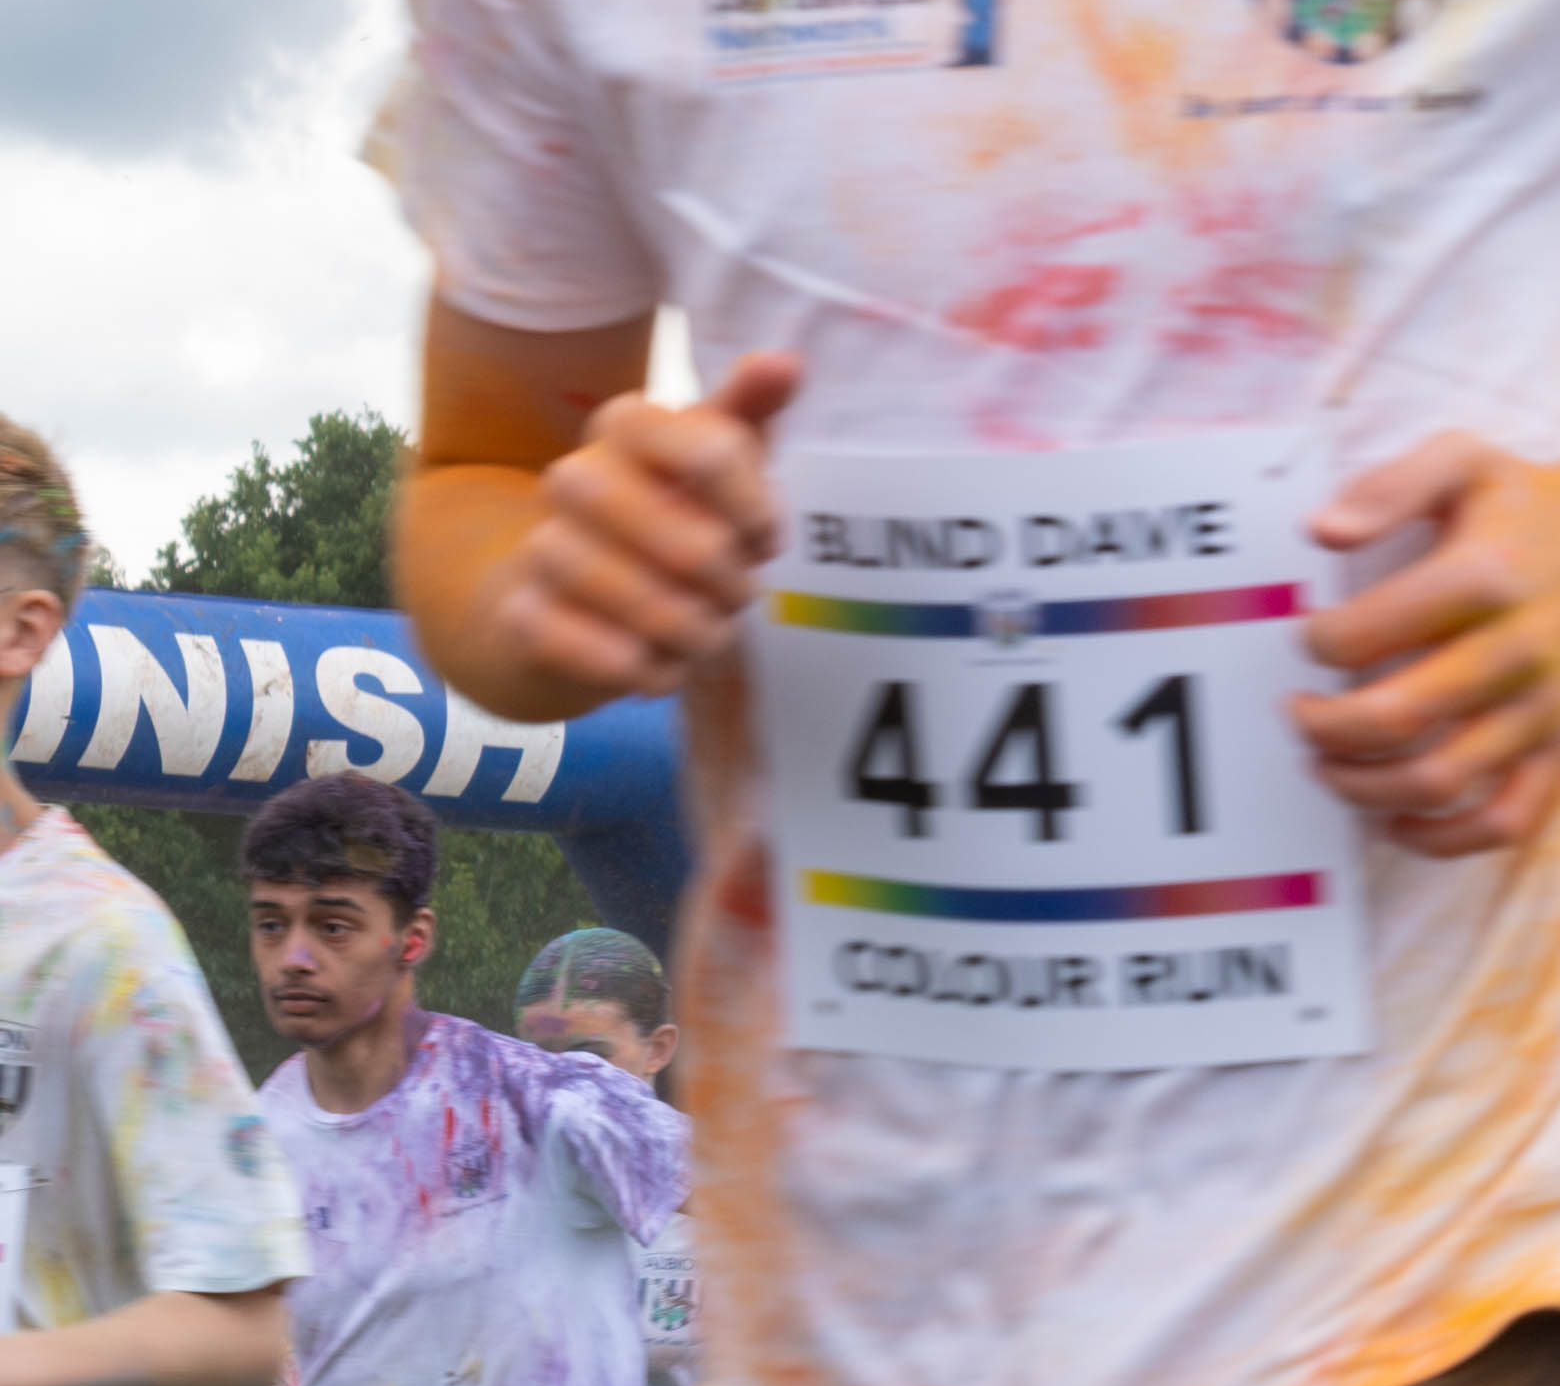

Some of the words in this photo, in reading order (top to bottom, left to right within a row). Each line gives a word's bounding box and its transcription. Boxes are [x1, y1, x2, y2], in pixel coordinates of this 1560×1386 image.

[806, 512, 996, 570] BLIND
[1020, 500, 1237, 567] DAVE
[10, 623, 566, 804] INISH
[838, 672, 1212, 843] 441
[832, 939, 1107, 1009] COLOUR
[1119, 942, 1293, 1004] RUN
